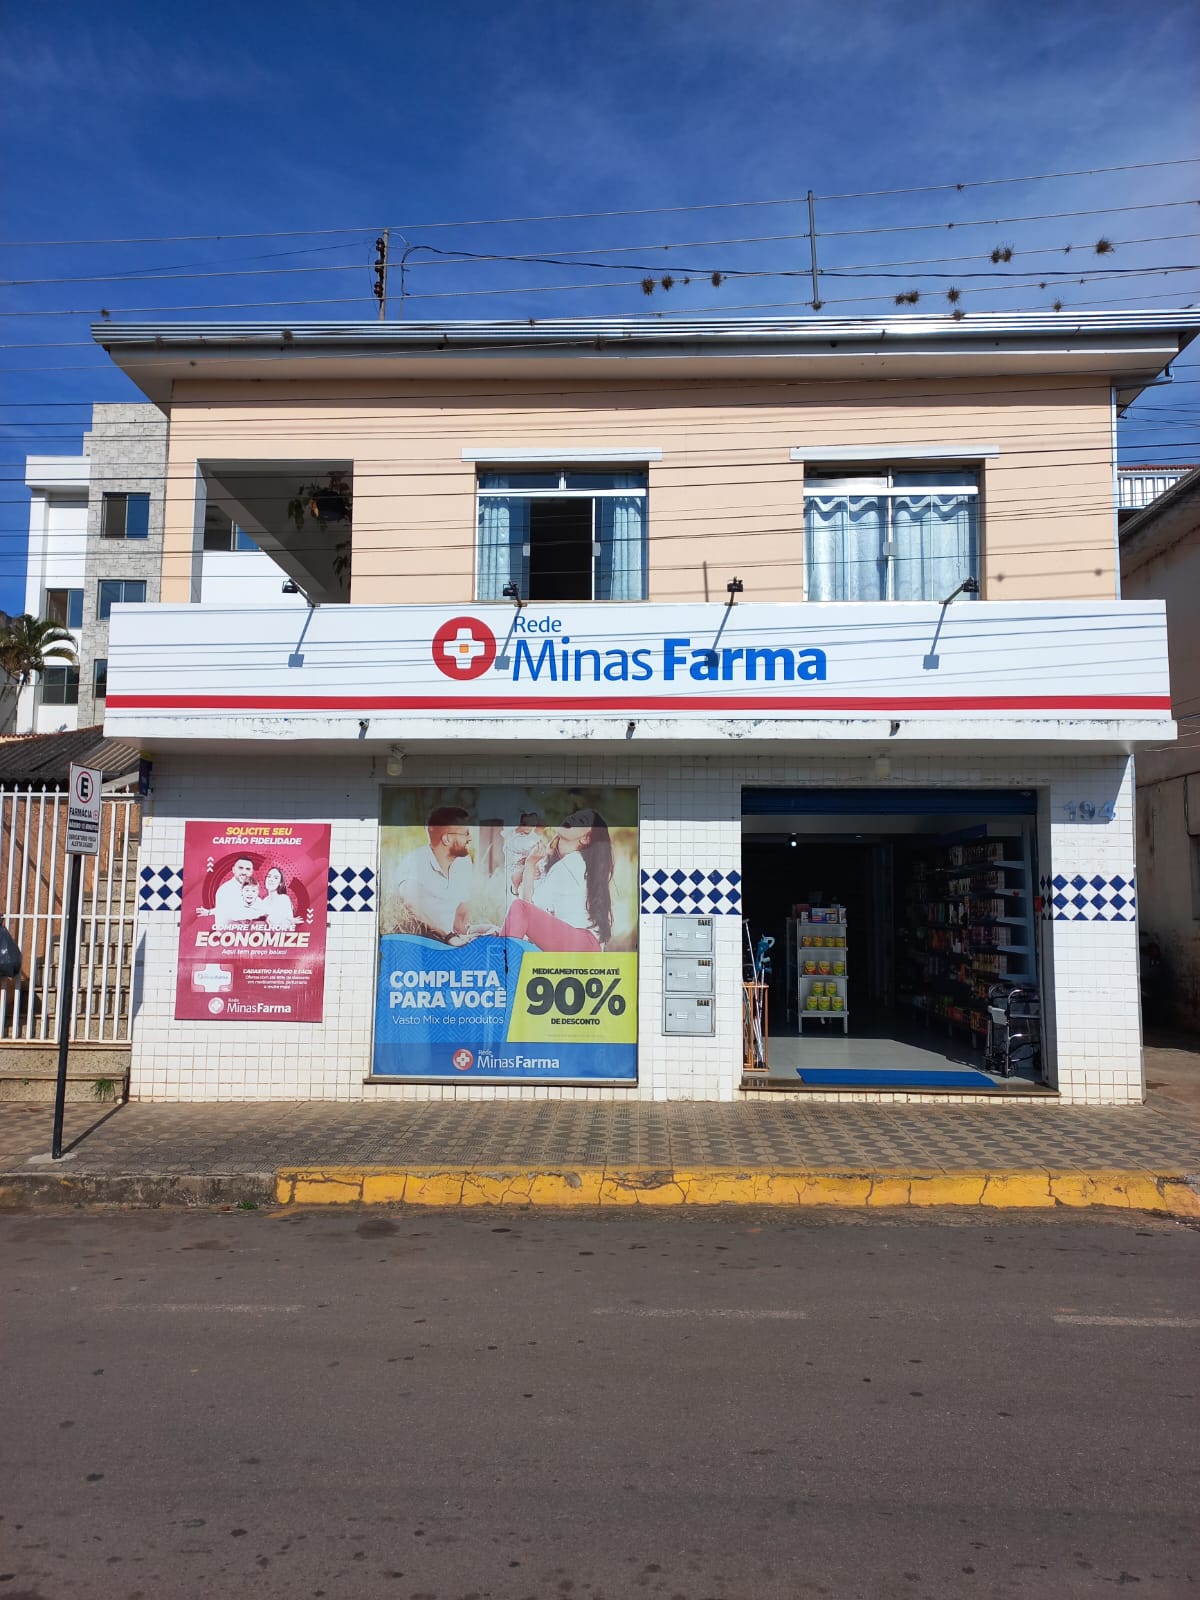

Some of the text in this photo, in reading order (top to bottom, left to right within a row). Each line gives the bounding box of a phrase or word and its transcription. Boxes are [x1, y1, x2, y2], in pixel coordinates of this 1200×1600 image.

[513, 615, 562, 633] Rede
[81, 777, 89, 797] E
[212, 835, 302, 845] CARTÃO FIDELIDADE
[226, 827, 292, 836] SOLICITE SEU
[195, 931, 311, 948] ECONOMIZE
[390, 970, 501, 988] COMPLETA
[606, 967, 621, 976] ATÉ
[389, 986, 507, 1008] PARA VOCÊ
[526, 976, 626, 1016] 90%
[392, 1015, 505, 1026] Vasto Mix de produtos
